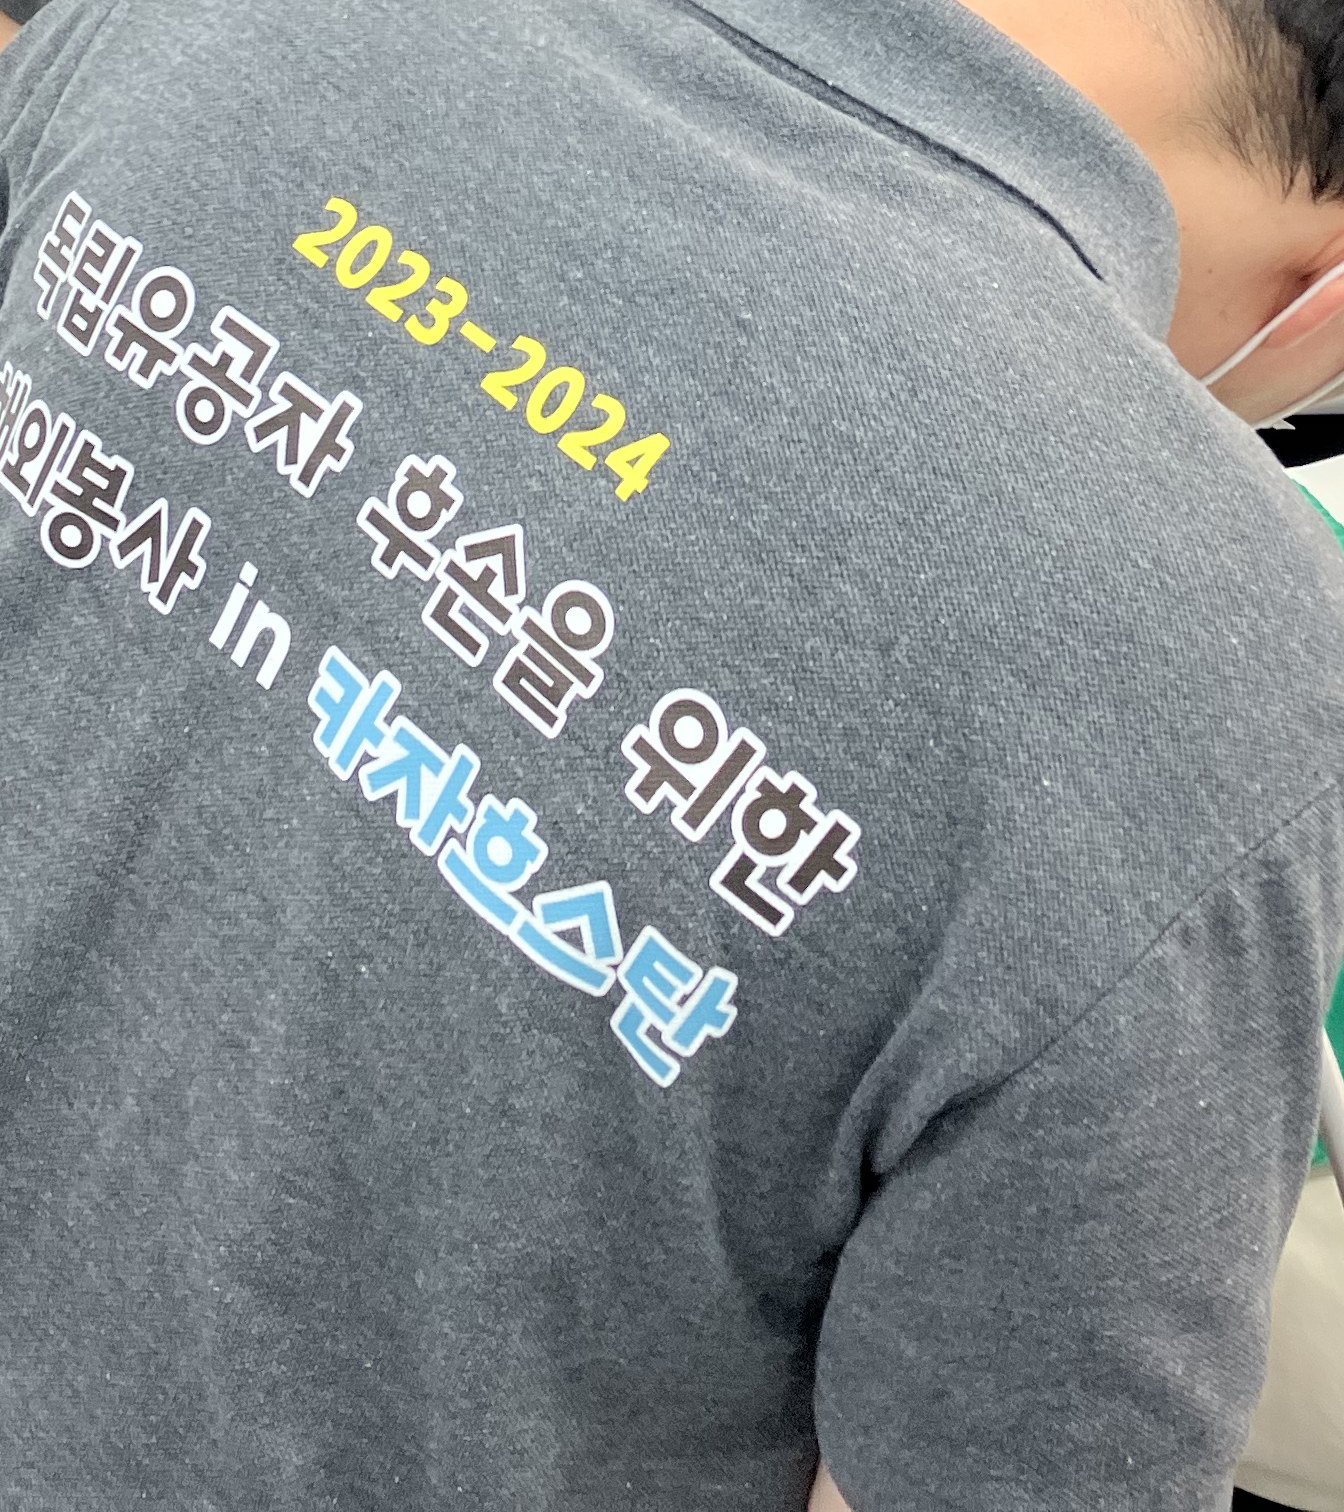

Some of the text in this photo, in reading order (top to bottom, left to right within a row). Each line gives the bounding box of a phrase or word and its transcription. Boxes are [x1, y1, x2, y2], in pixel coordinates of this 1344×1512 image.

[36, 191, 861, 936] 독립유공자 후손을 위한
[292, 196, 670, 501] 2023-2024
[209, 563, 292, 689] in
[308, 645, 738, 1088] 카자흐스탄
